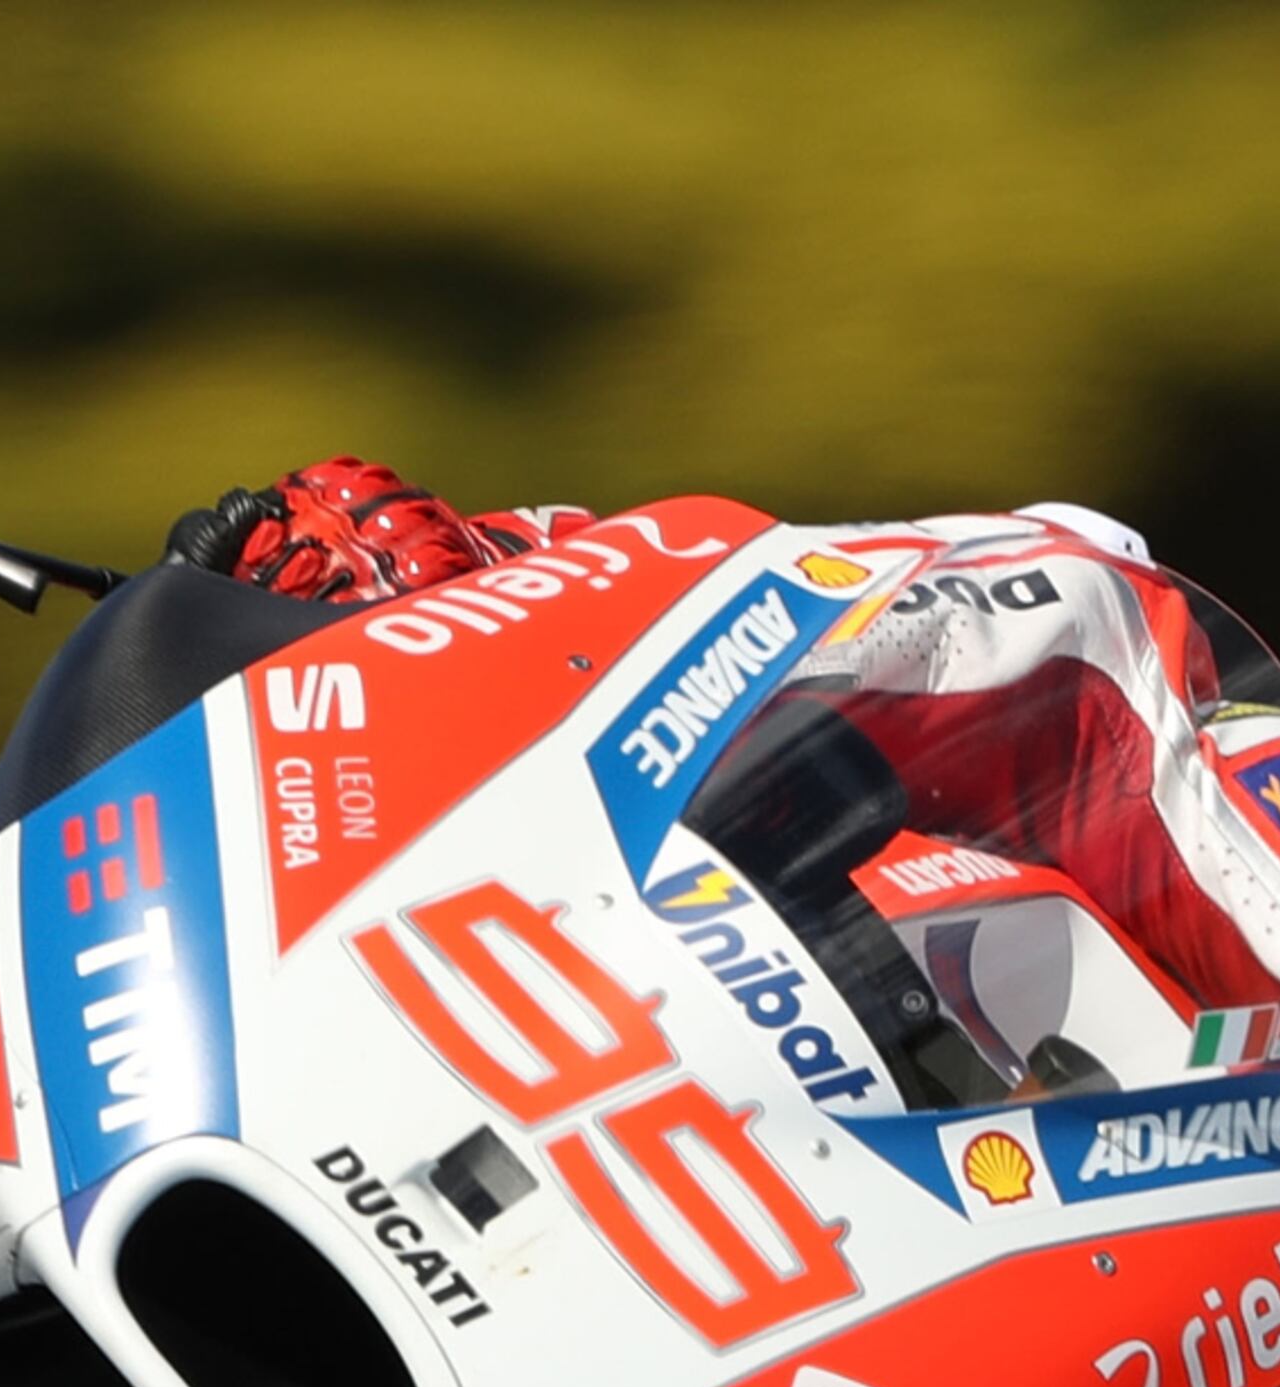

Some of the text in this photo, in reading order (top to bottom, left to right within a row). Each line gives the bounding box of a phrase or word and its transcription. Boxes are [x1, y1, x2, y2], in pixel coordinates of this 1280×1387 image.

[366, 540, 630, 654] riello
[621, 588, 797, 788] ADVANCE
[275, 757, 319, 869] CUPRA
[335, 756, 377, 840] LEON
[75, 905, 187, 1133] TIM
[350, 879, 861, 1350] 99
[312, 1145, 494, 1328] DUCATI
